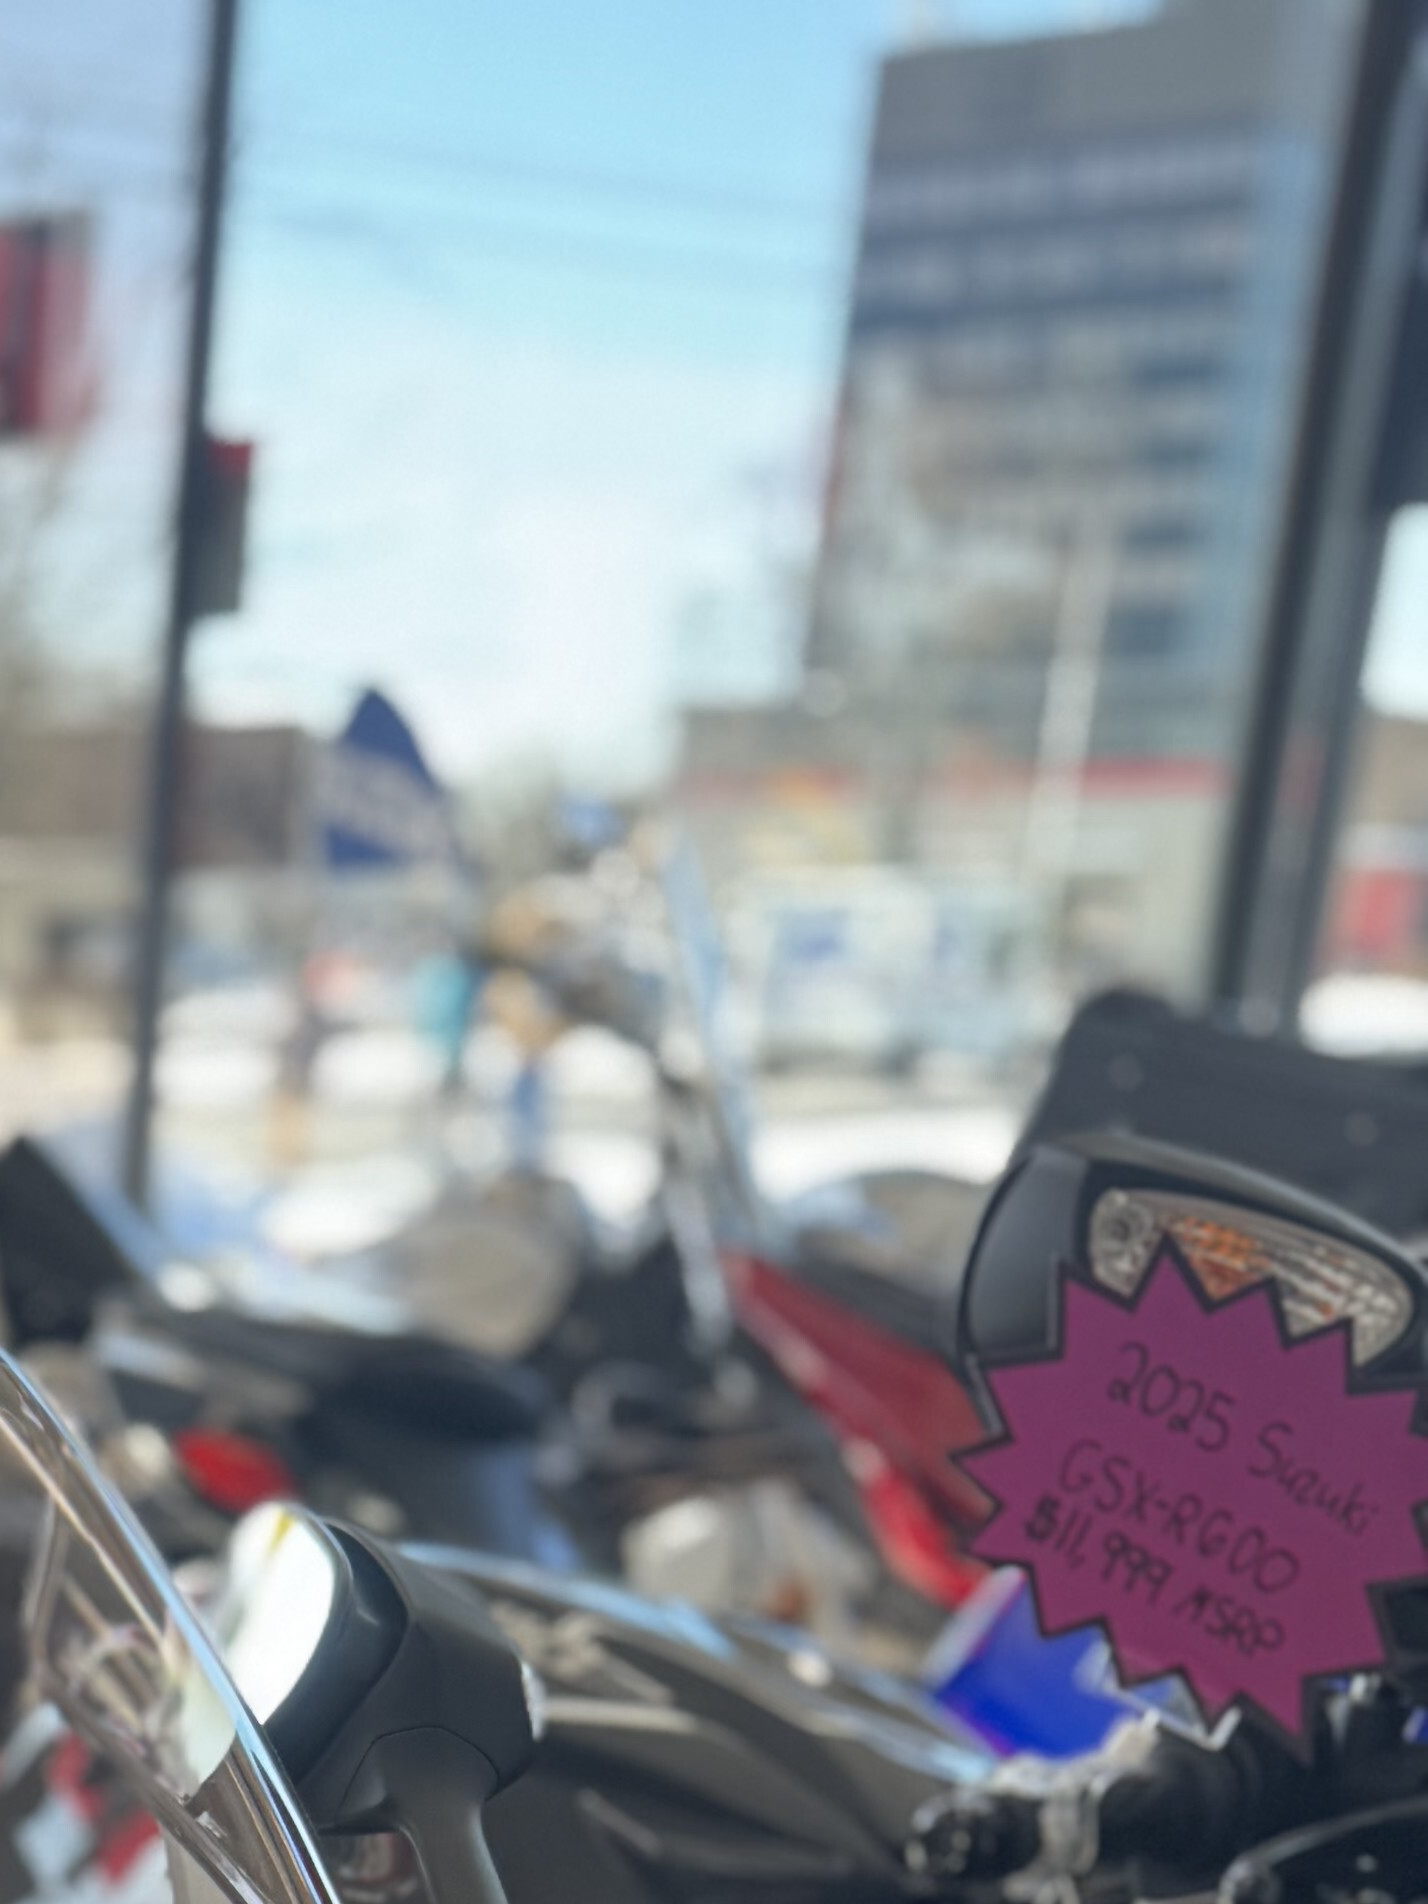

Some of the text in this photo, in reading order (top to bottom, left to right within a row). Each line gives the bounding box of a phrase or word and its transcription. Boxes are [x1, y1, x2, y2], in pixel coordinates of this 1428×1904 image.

[1059, 1439, 1300, 1594] GSX-R600
[1107, 1342, 1382, 1537] 2025 Suzuki
[1173, 1586, 1286, 1658] MSRP
